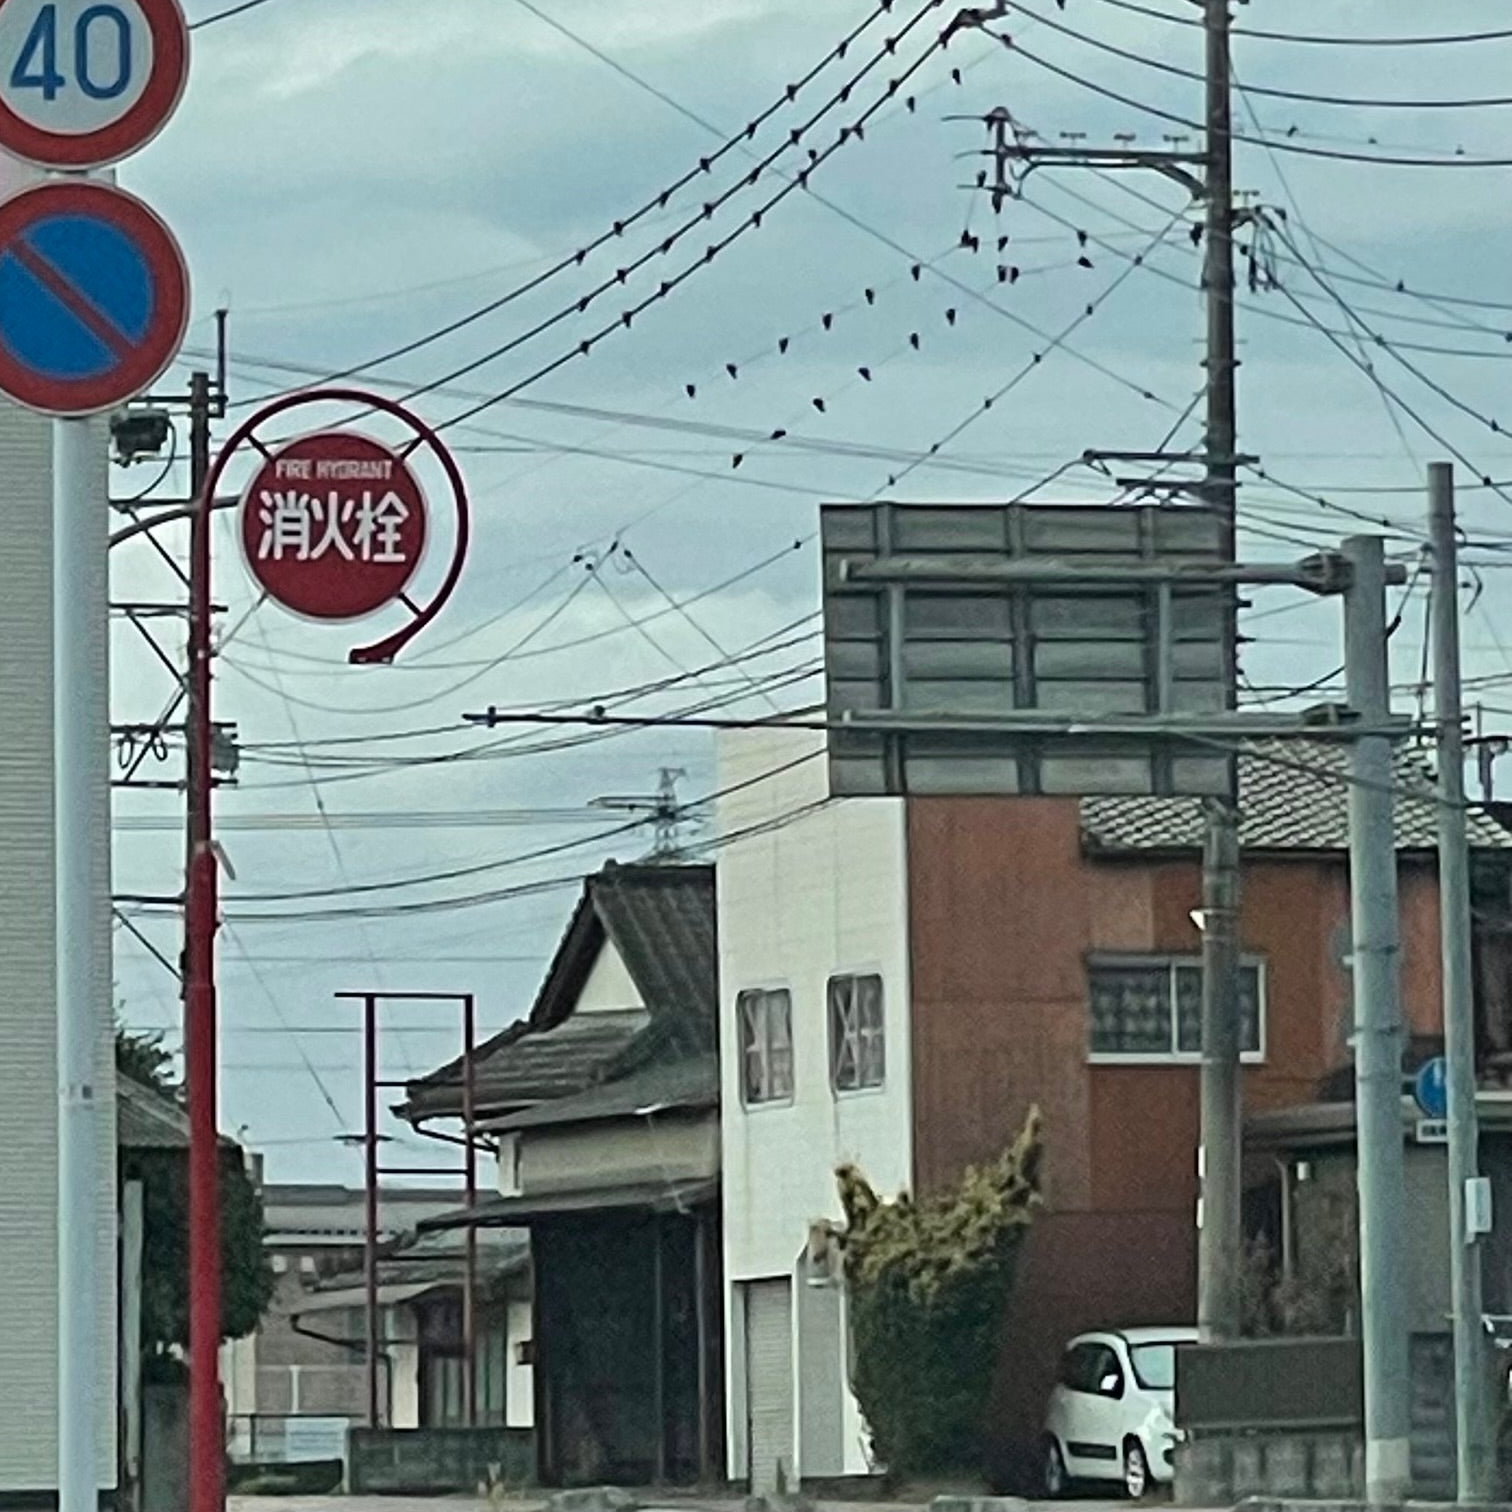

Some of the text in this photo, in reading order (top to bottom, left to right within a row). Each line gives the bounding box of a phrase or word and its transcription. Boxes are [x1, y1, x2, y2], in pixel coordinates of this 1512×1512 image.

[10, 3, 131, 101] 40
[276, 459, 393, 480] FIRE HYDRANT
[258, 491, 410, 562] 消火栓
